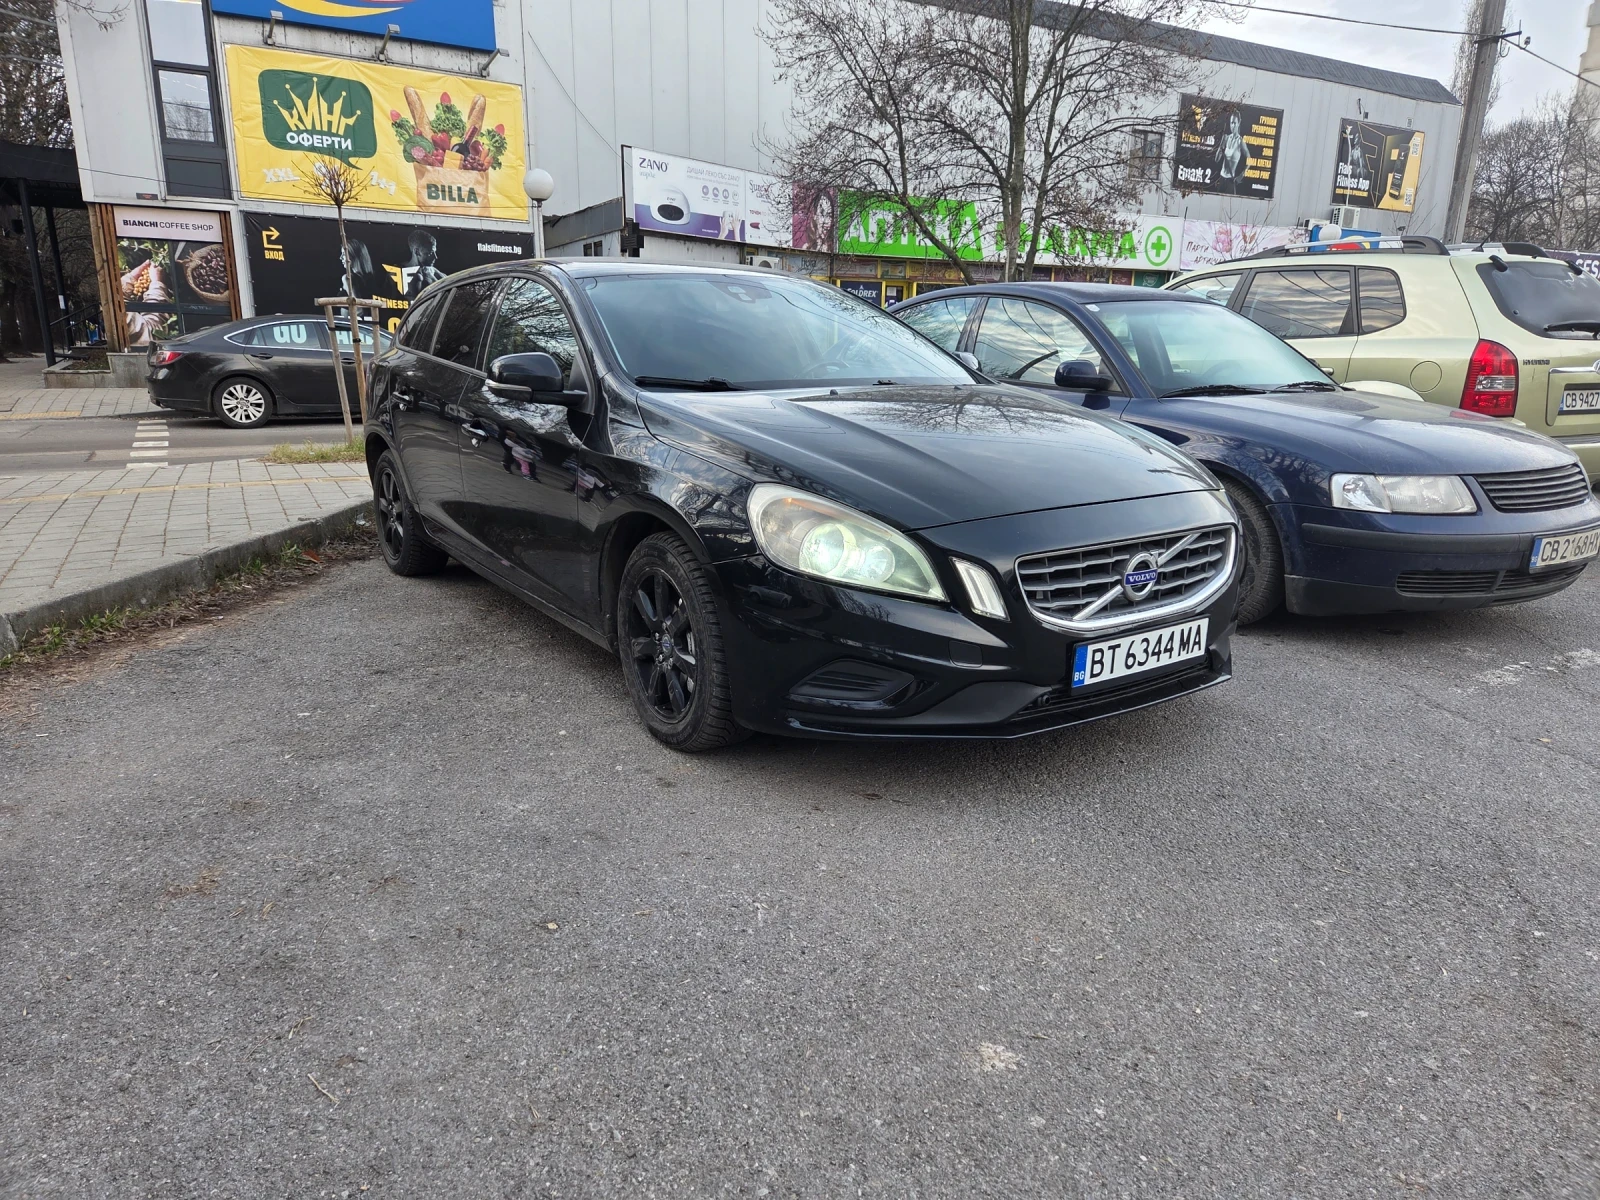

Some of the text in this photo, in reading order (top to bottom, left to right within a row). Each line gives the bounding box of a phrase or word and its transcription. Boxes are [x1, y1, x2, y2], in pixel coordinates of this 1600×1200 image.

[273, 77, 361, 136] КИНГ
[286, 132, 353, 150] ОФЕРТИ
[639, 157, 669, 173] ZANO
[263, 168, 300, 184] XXL
[1204, 167, 1212, 184] 2
[1358, 178, 1370, 191] App
[426, 183, 479, 204] BILLA
[122, 219, 214, 231] BIANCHI COFFEE SHOP
[264, 250, 285, 261] ВХОД
[1565, 391, 1600, 408] CB 9427
[1540, 540, 1560, 562] CB
[1127, 571, 1156, 583] VOLVO
[1090, 624, 1202, 679] BT 6344 MA
[1073, 670, 1085, 682] BG
